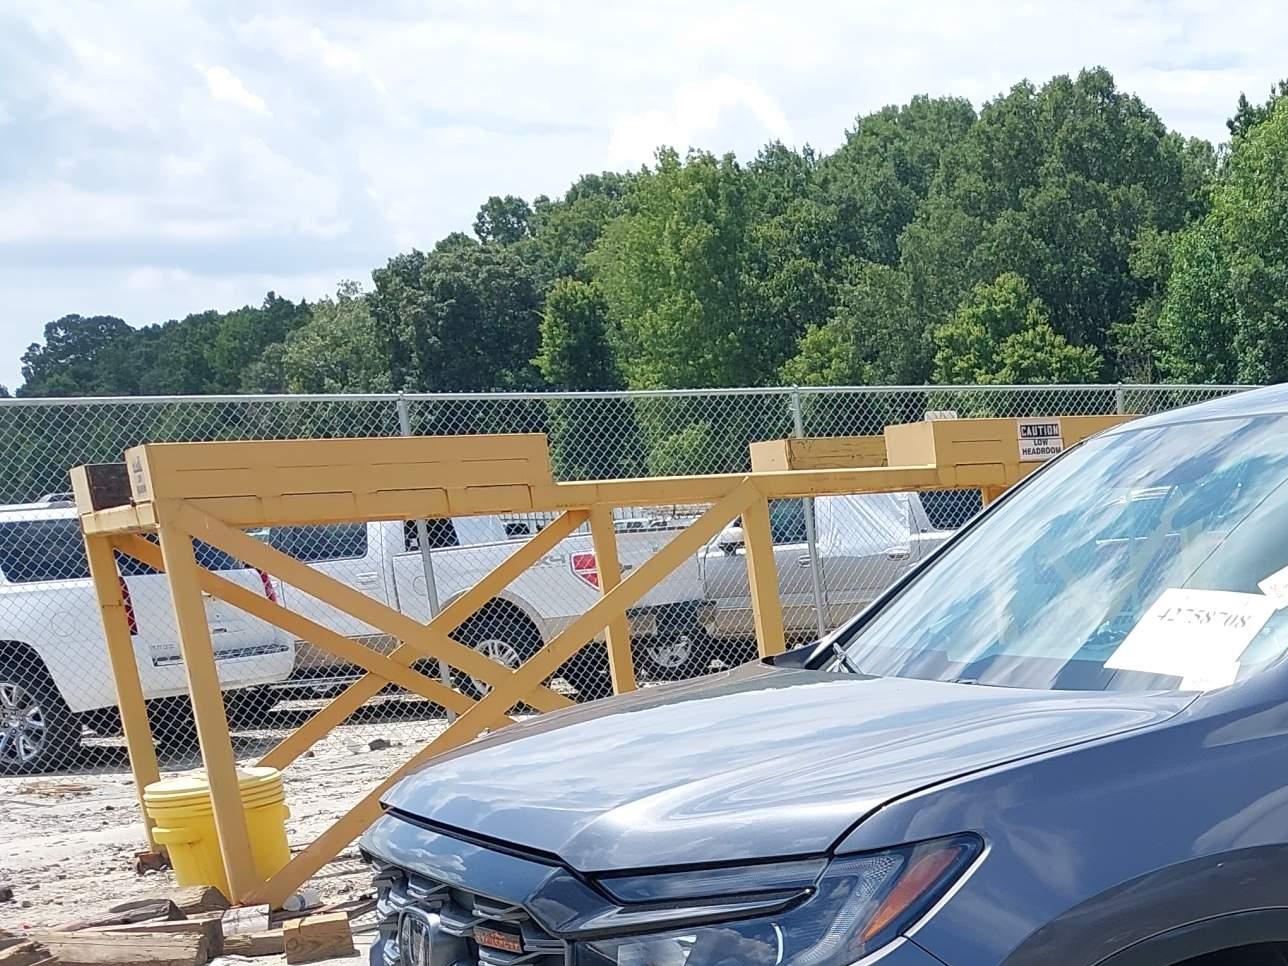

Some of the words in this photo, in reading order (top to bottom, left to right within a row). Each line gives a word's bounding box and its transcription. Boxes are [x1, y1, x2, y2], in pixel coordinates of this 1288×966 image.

[1021, 425, 1058, 436] CAUTION
[1033, 438, 1049, 446] LOW
[1022, 447, 1061, 455] HEADROOM
